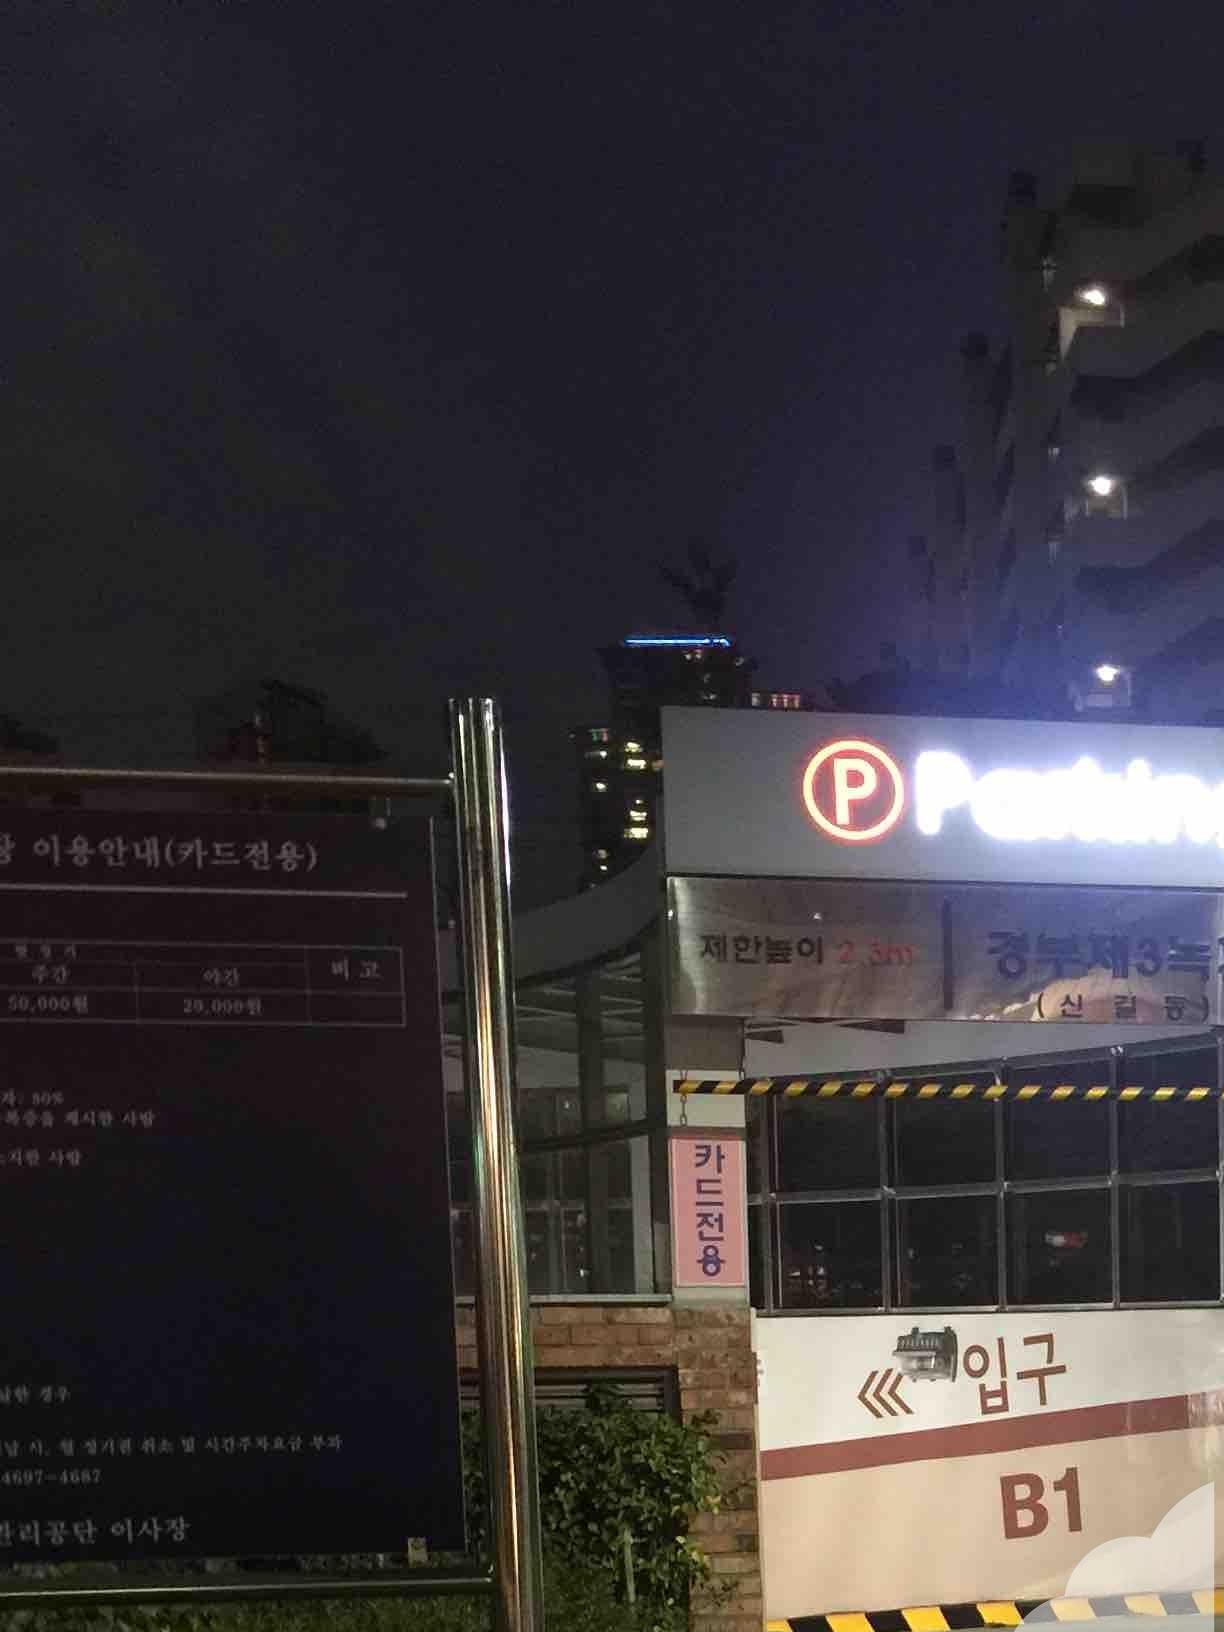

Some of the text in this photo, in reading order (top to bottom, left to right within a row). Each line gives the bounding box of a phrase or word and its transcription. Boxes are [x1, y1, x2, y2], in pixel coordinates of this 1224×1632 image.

[32, 833, 321, 873] 이용안내(카드전용)
[698, 932, 824, 968] 제한높이
[693, 1144, 726, 1277] 카드전용
[962, 1331, 1068, 1416] 입구
[110, 1515, 193, 1545] 이사장
[1000, 1466, 1083, 1540] B1
